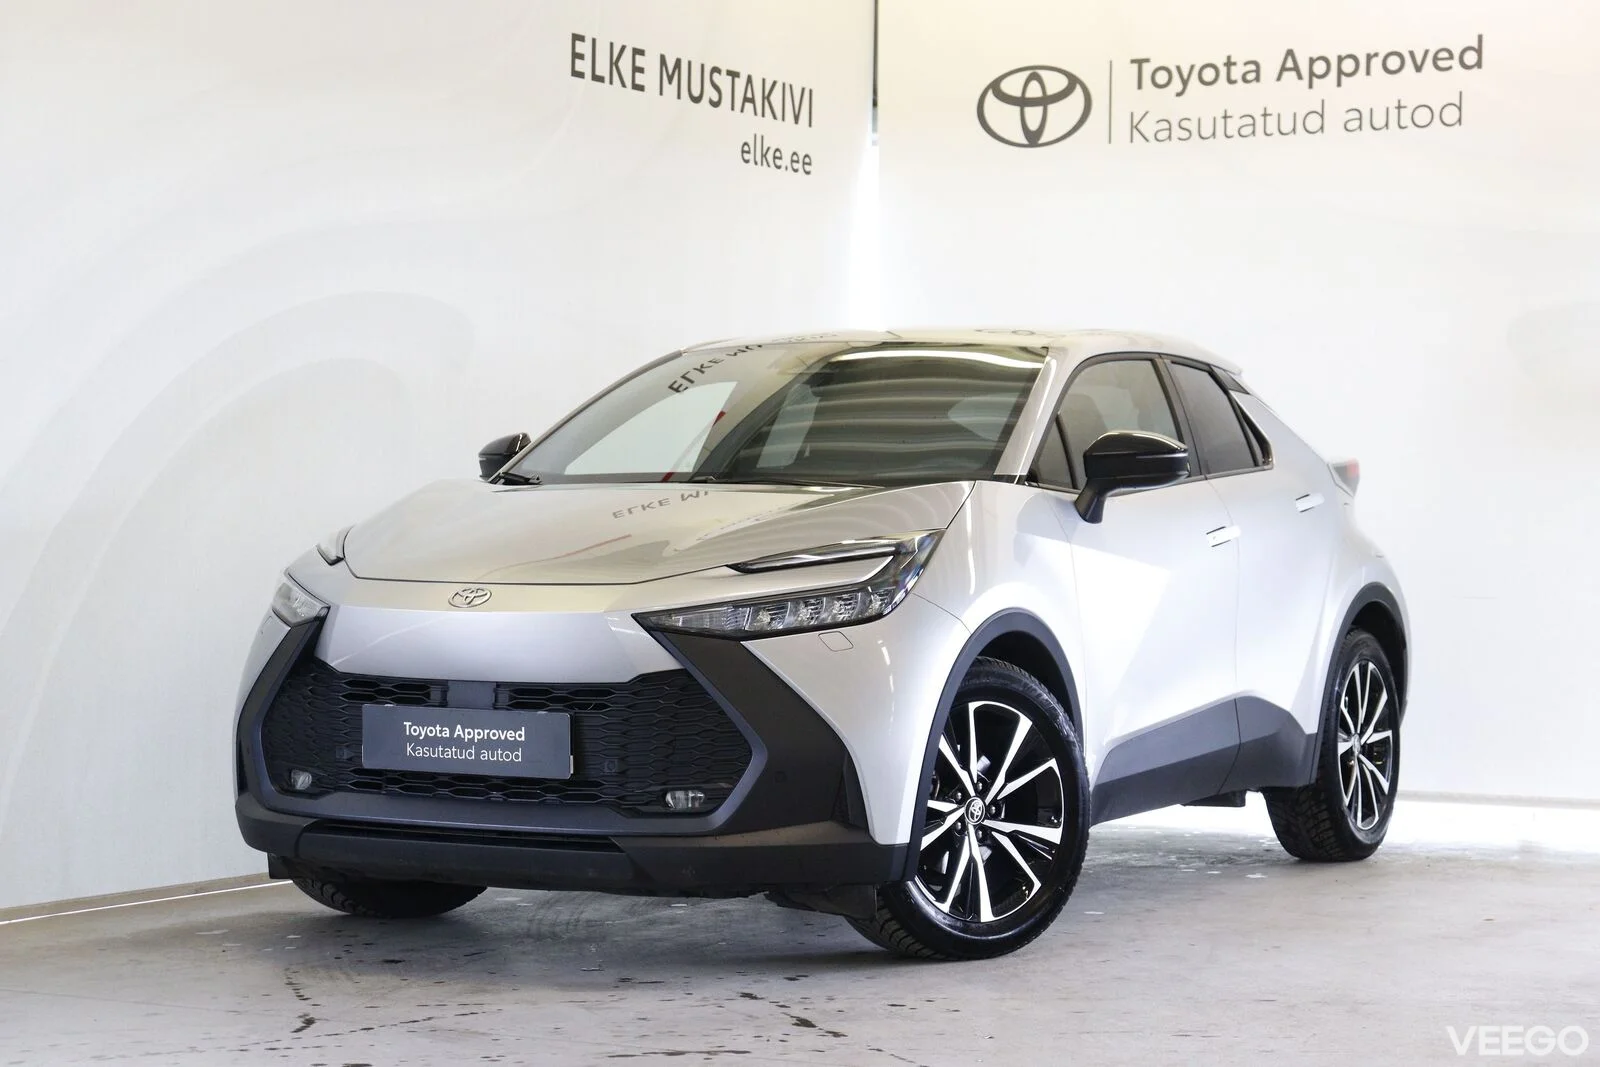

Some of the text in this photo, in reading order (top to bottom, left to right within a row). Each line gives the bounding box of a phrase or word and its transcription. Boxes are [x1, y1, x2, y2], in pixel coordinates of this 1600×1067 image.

[570, 32, 813, 128] ELKE MUSTAKIVI
[1129, 33, 1484, 97] Toyota Approved
[1129, 90, 1463, 144] Kasutatud autod
[740, 133, 813, 175] elke.ee
[403, 721, 526, 742] Toyota Approved
[406, 742, 523, 763] Kasutatud autod
